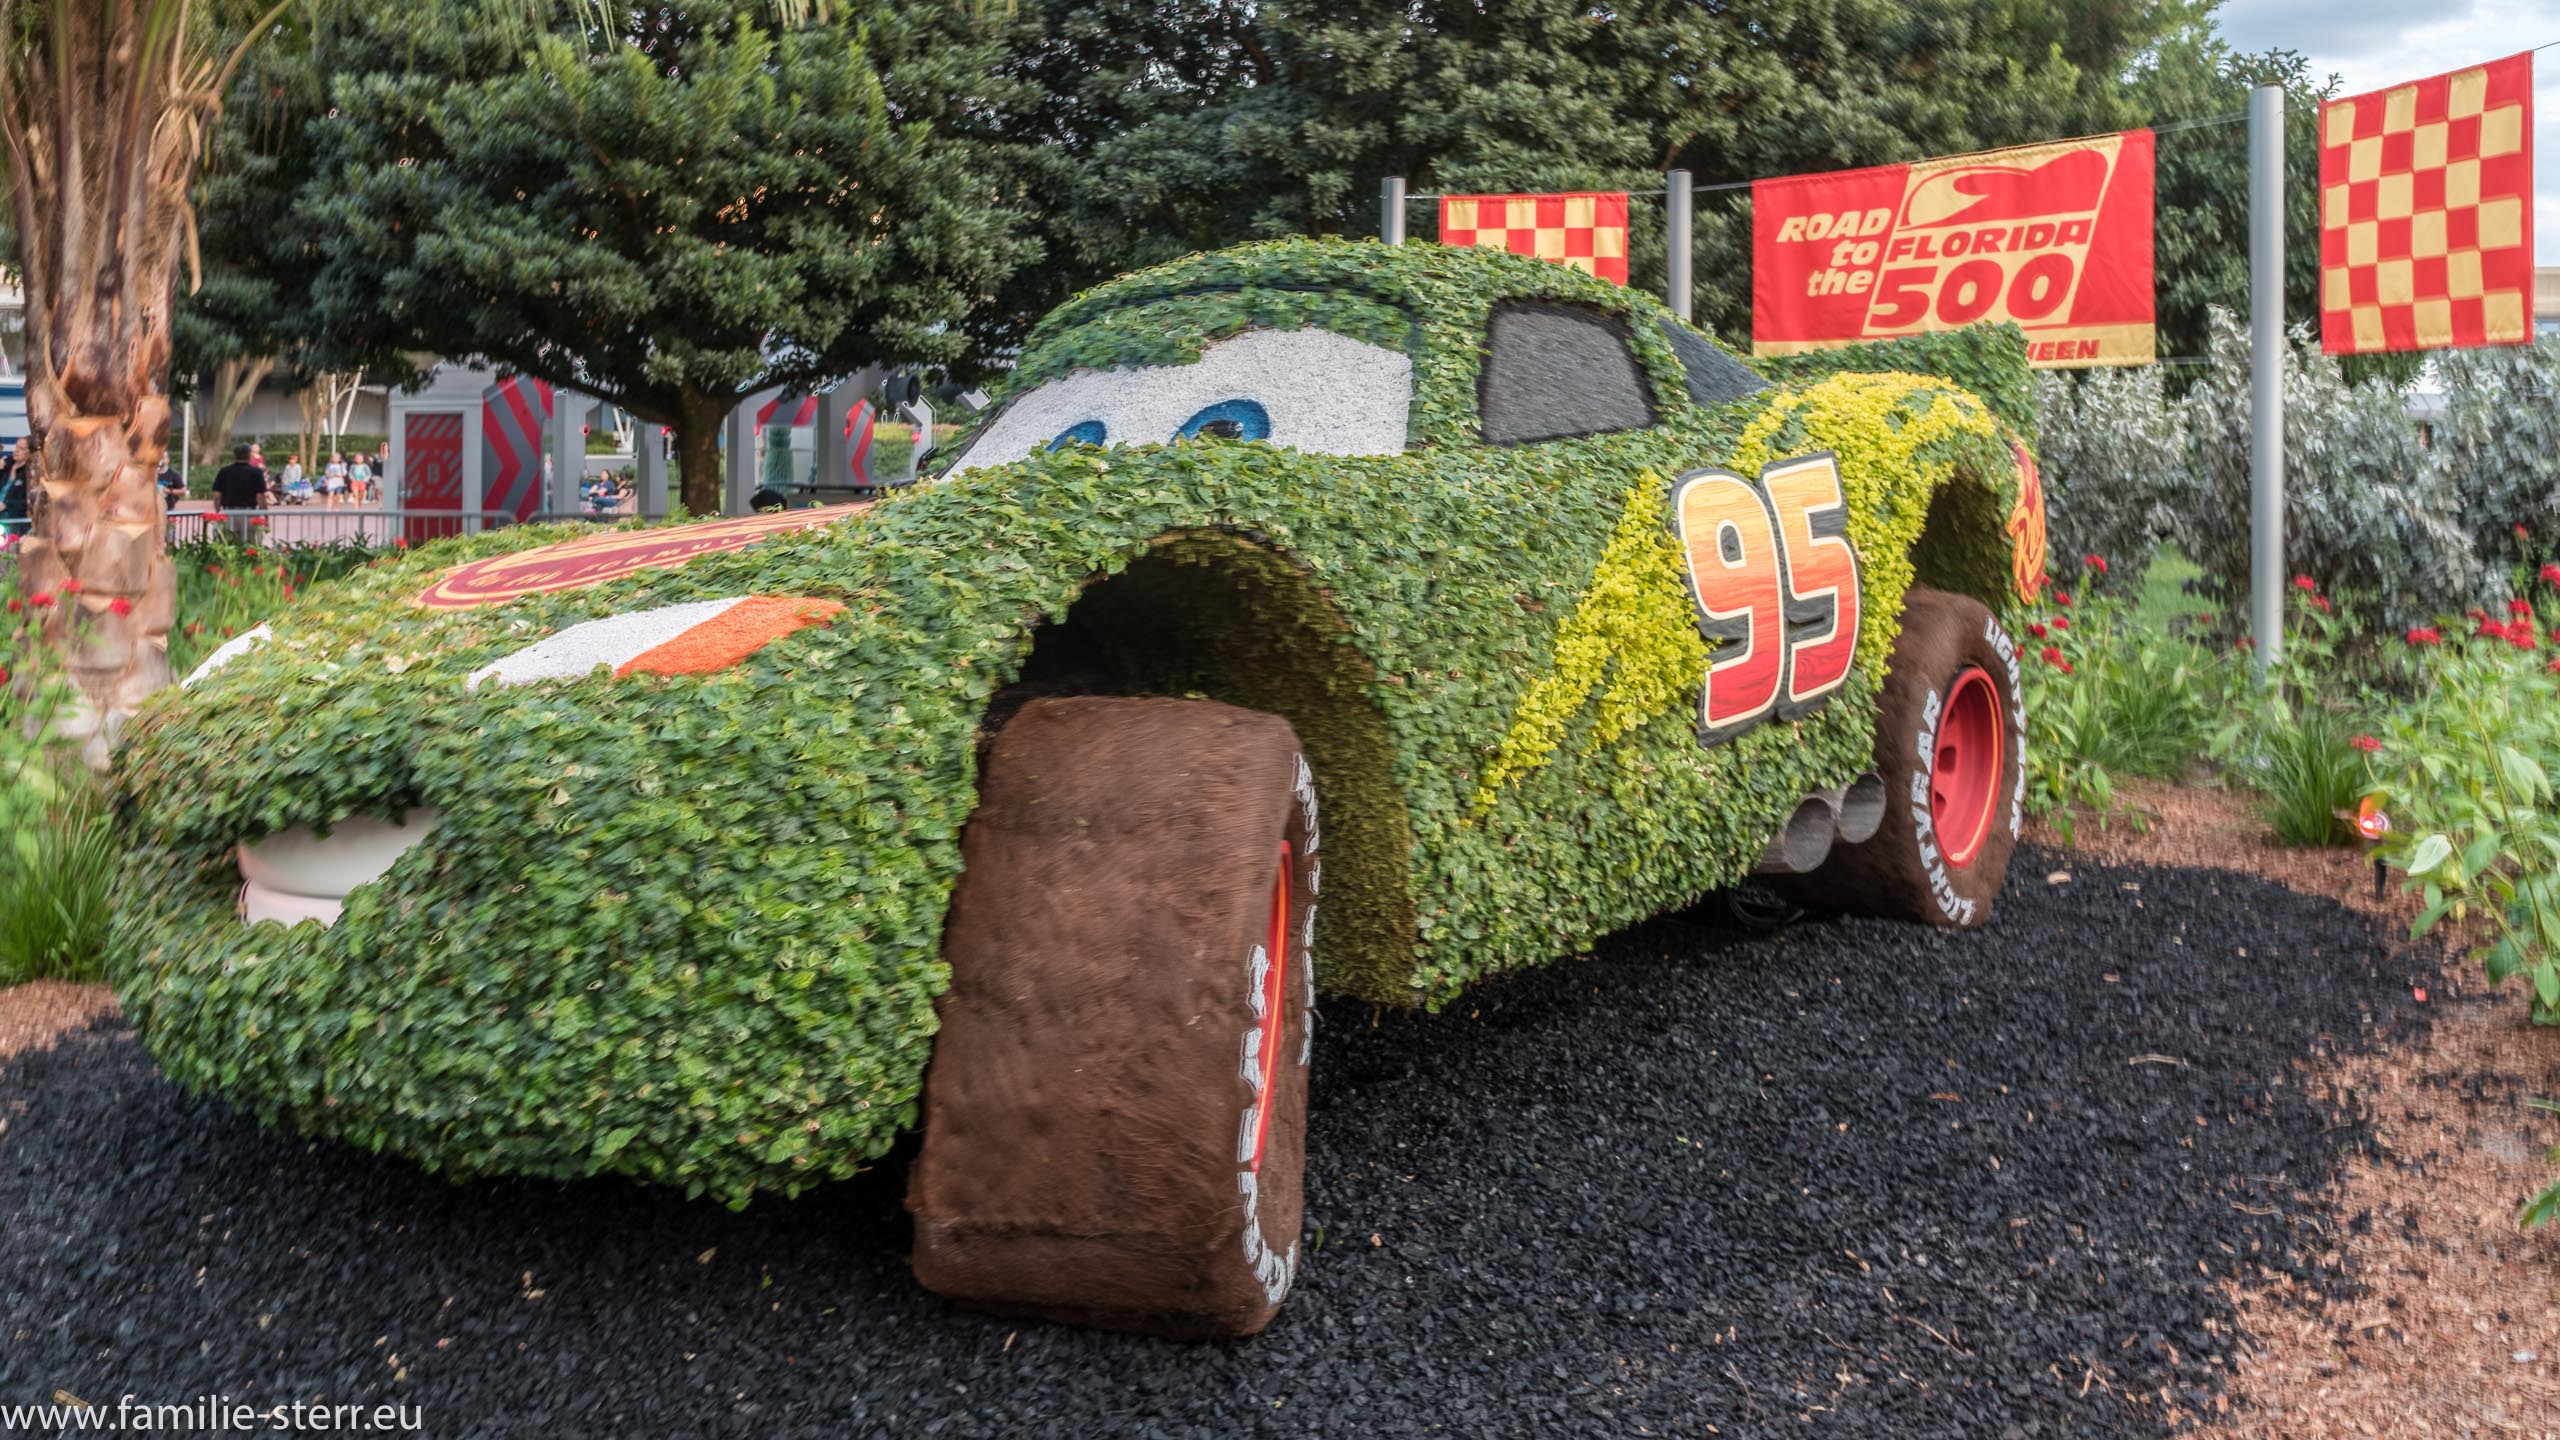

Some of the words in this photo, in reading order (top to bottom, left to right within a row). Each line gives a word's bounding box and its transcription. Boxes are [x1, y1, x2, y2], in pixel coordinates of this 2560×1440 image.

[1776, 208, 1892, 243] ROAD
[1886, 218, 2093, 263] FLORIDA
[1830, 240, 1880, 267] to
[1807, 267, 1874, 297] the
[1868, 252, 2074, 329] 500
[1676, 454, 1861, 732] 95
[1911, 688, 1977, 926] LIGHTYEAR
